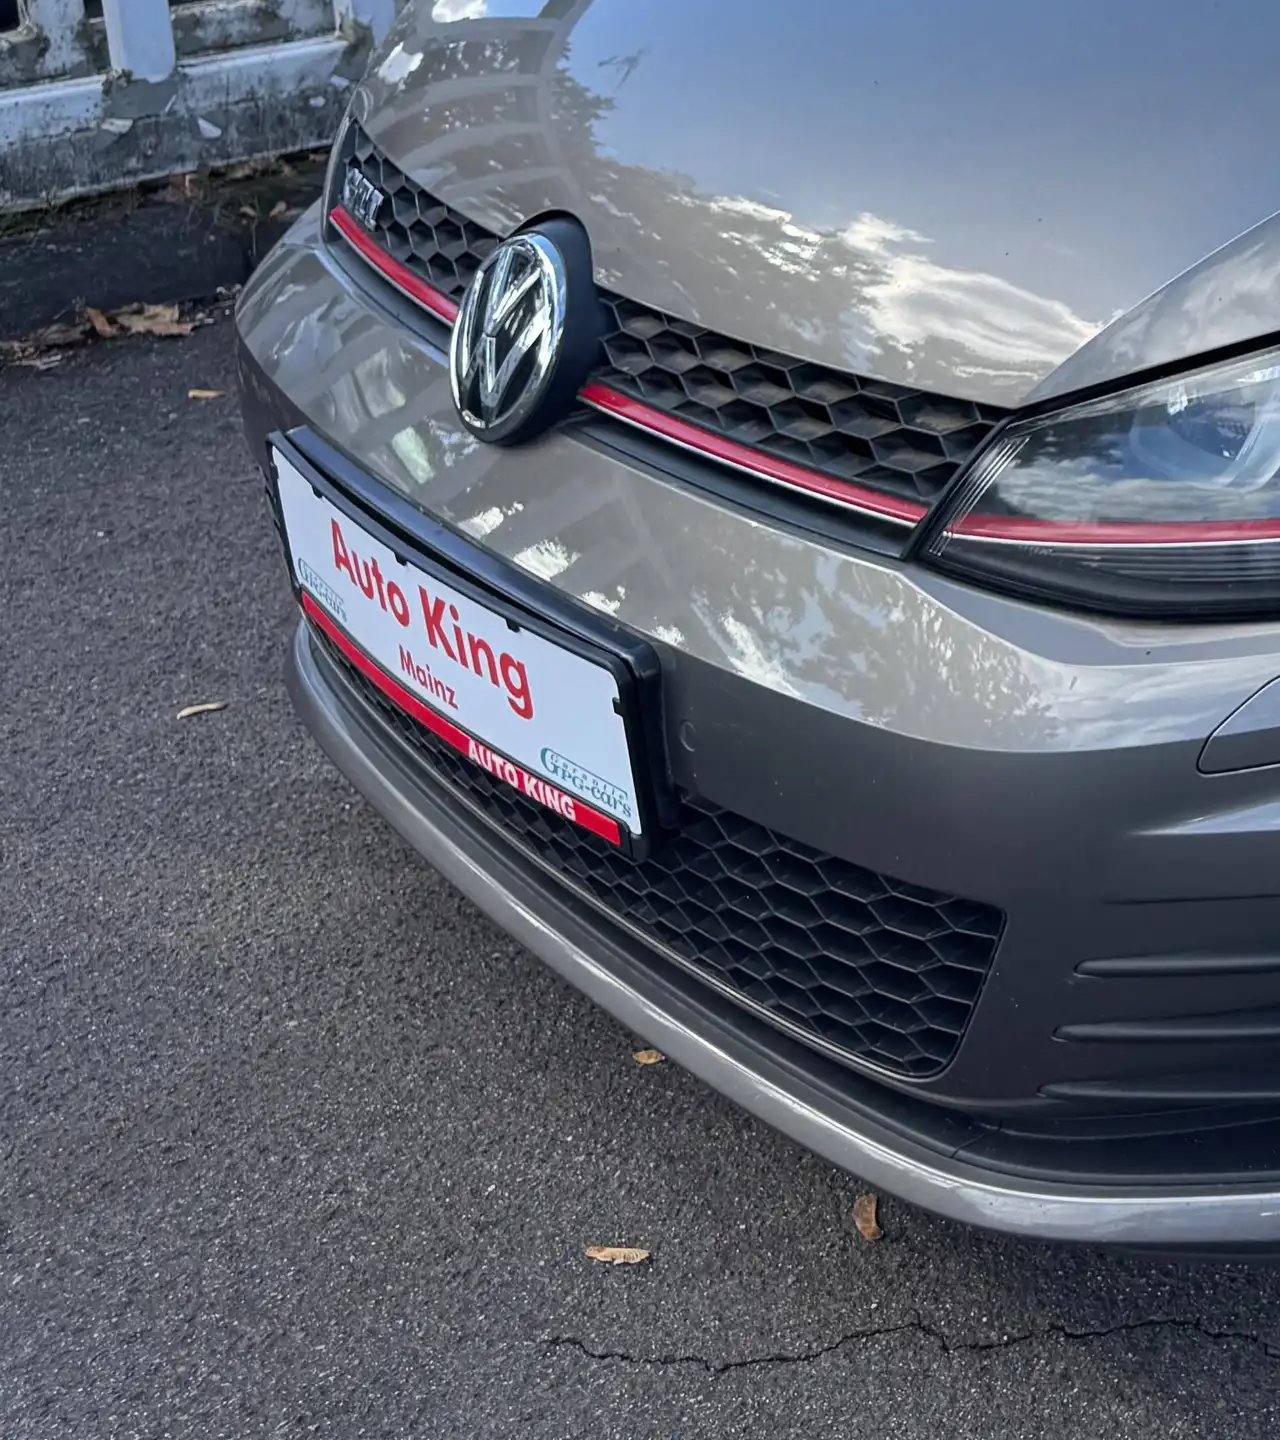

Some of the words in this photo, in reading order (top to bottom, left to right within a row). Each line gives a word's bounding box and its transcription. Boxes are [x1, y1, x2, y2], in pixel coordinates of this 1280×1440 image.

[331, 517, 412, 628] Auto
[418, 584, 535, 720] King
[398, 643, 459, 710] Mainz
[468, 739, 519, 789] AUTO
[523, 772, 577, 822] KING
[540, 747, 632, 819] GPG-cars
